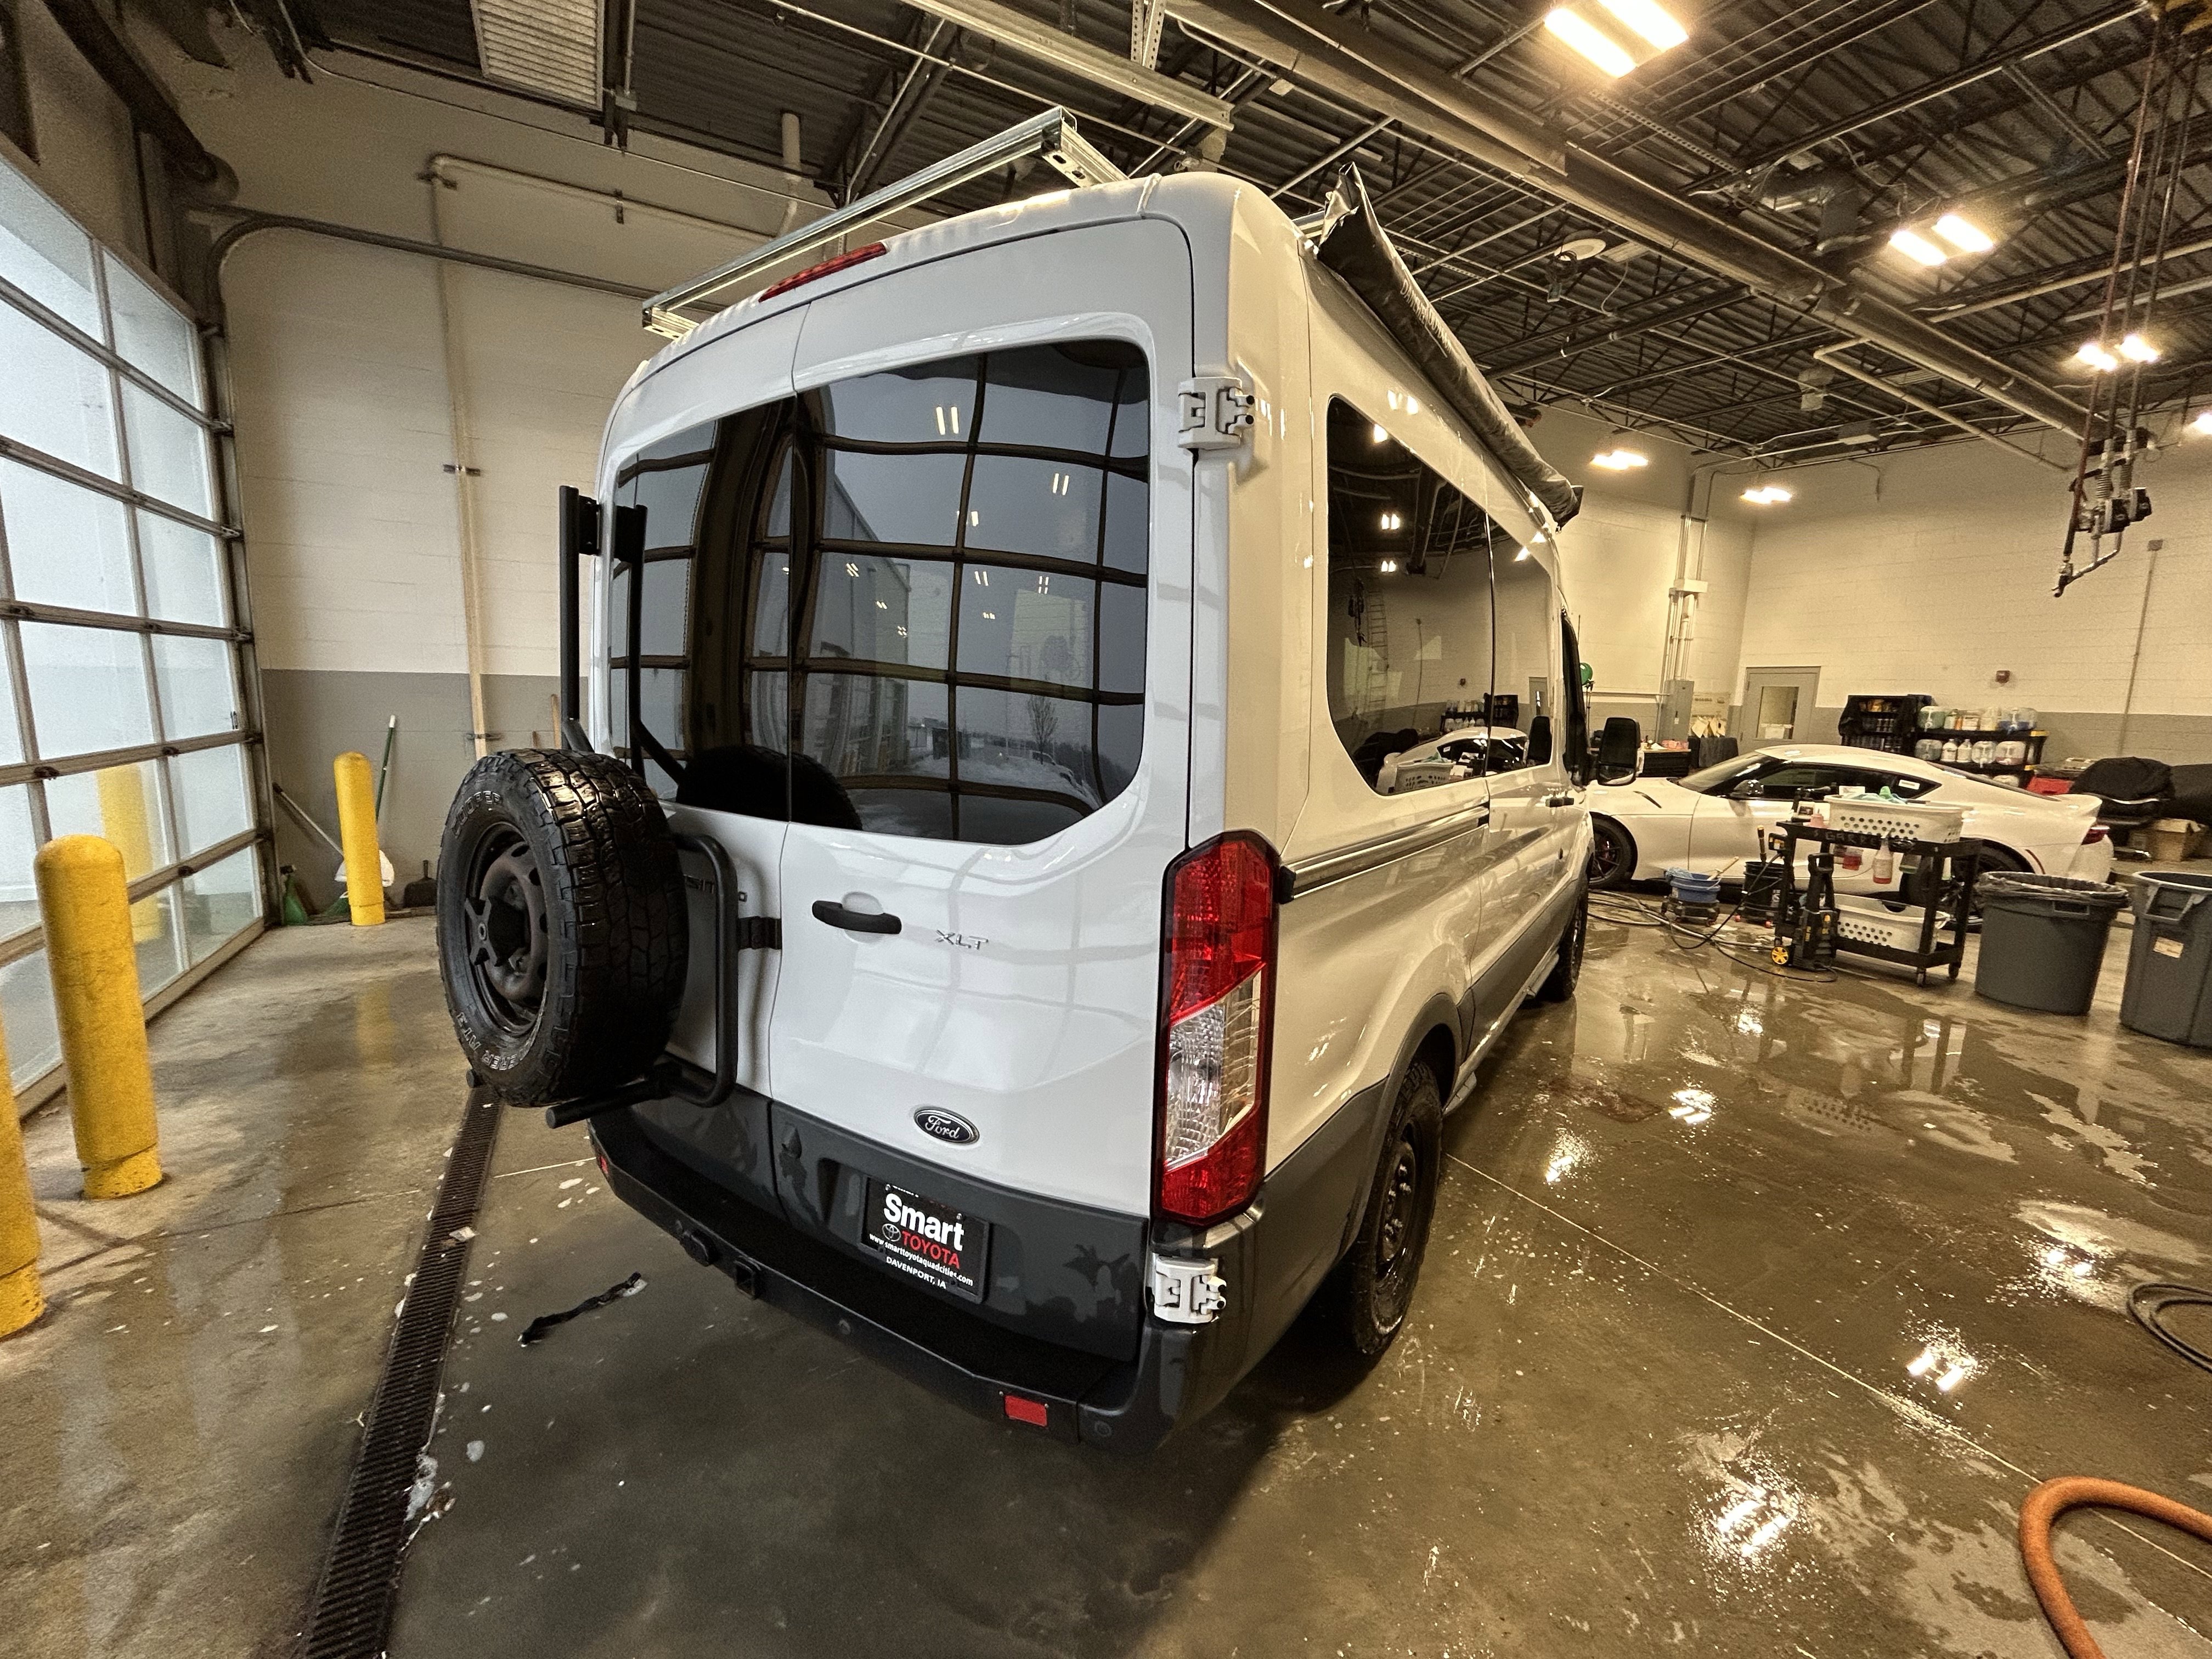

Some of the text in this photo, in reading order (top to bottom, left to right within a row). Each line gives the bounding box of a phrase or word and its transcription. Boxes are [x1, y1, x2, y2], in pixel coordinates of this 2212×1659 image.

[452, 791, 503, 839] COOPER
[935, 929, 988, 950] XLT
[924, 1115, 961, 1139] Ford
[883, 1193, 964, 1251] Smart
[869, 1233, 973, 1286] wwwsmarttoyotaquadcities.com
[901, 1229, 960, 1269] TOYOTA
[886, 1256, 947, 1289] DAVENPORT, IA
